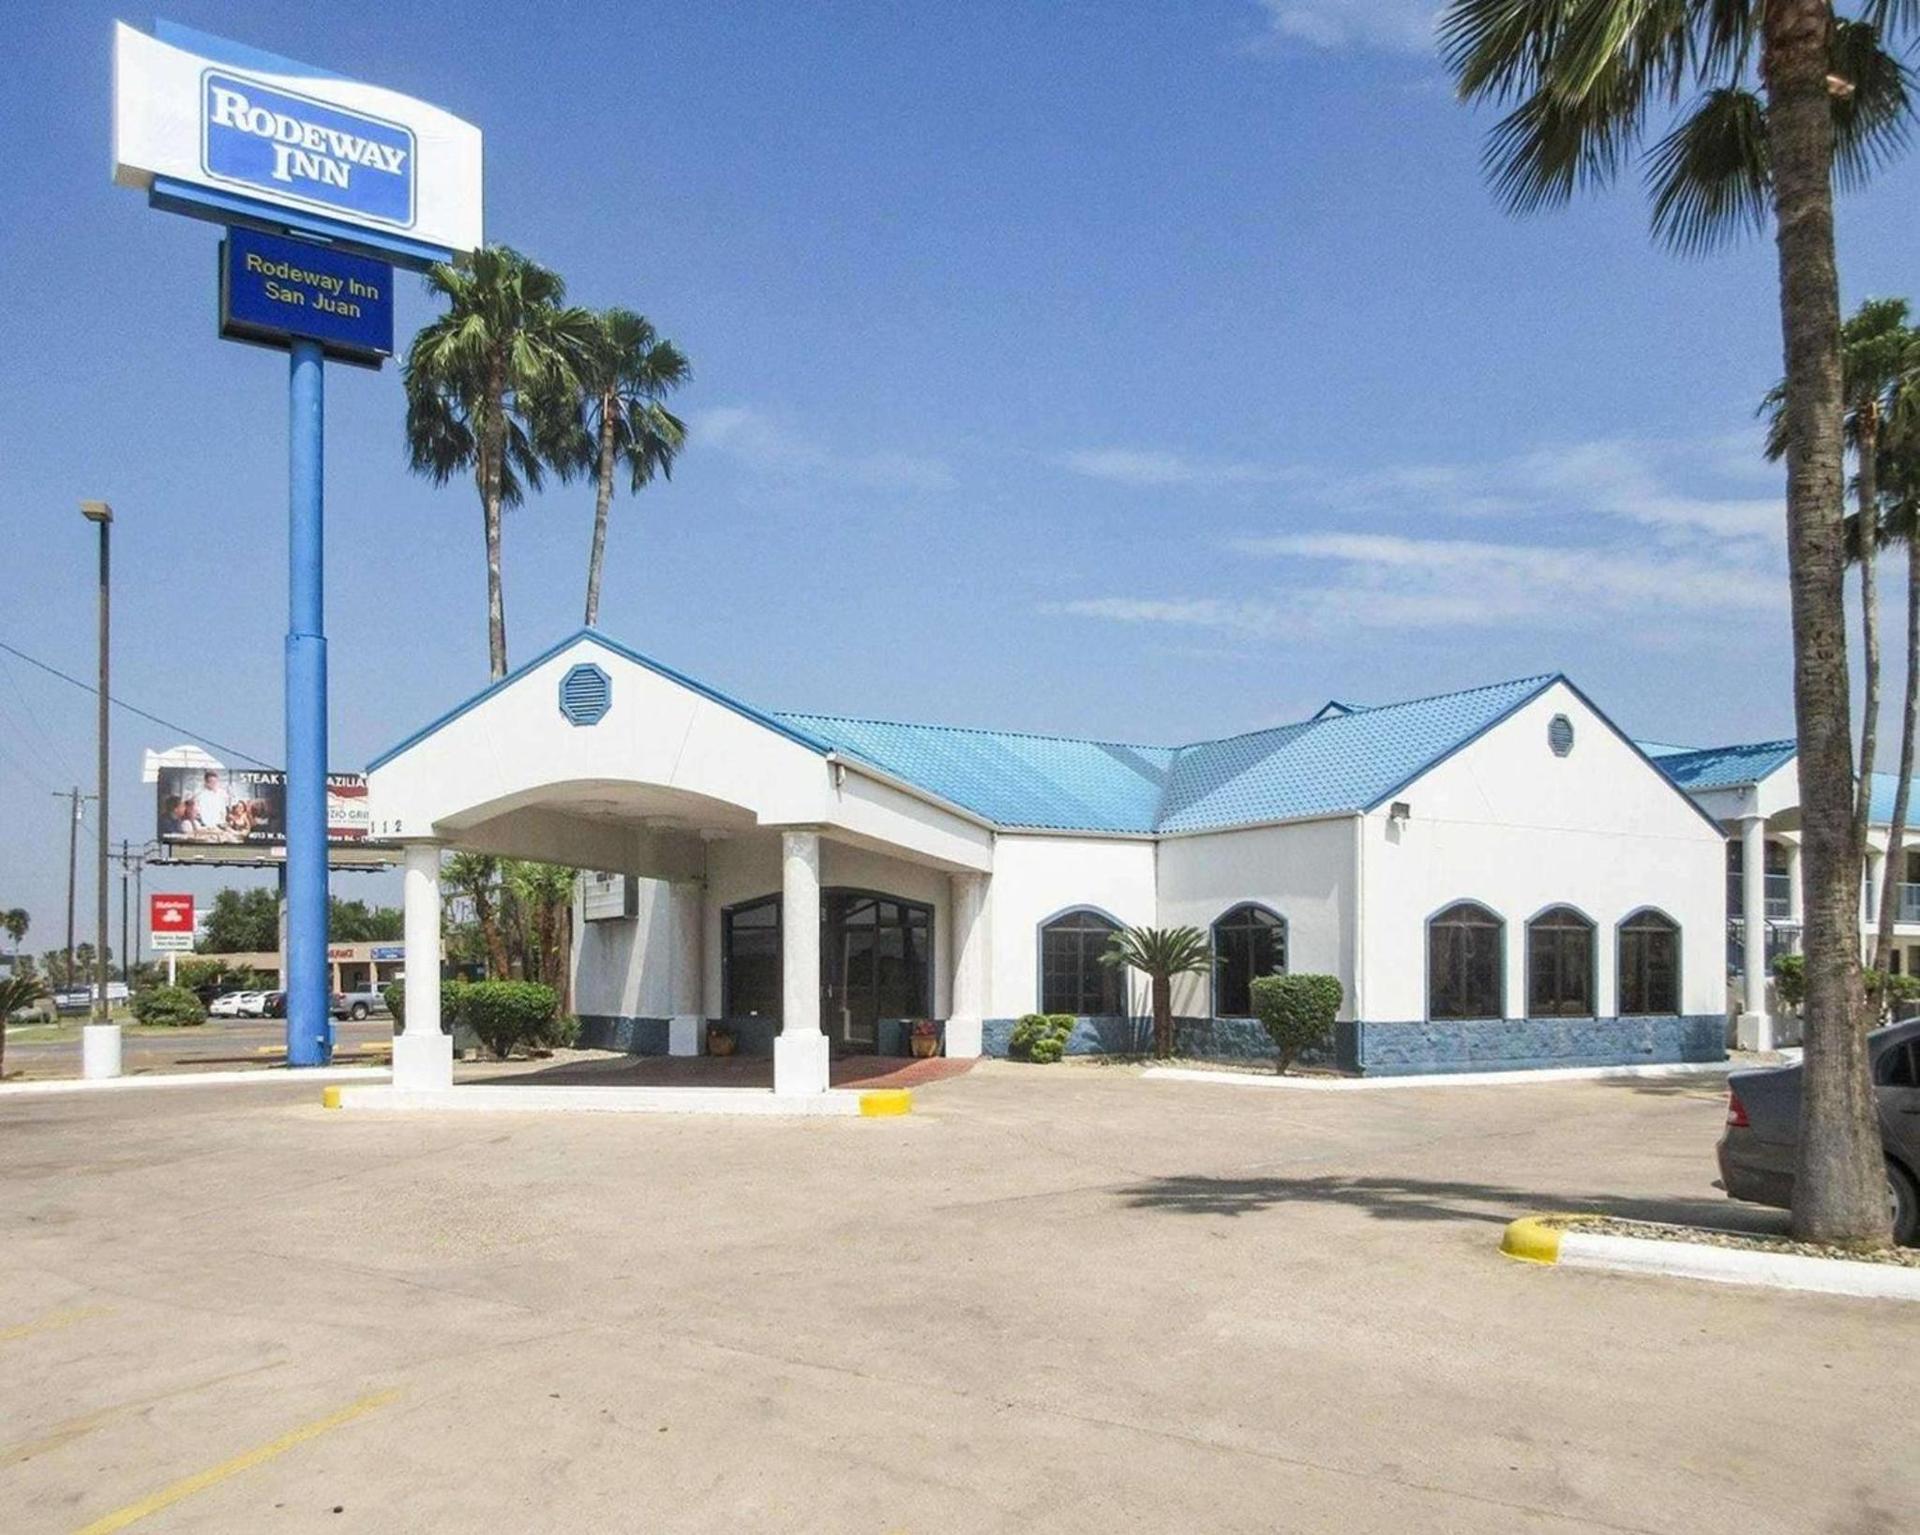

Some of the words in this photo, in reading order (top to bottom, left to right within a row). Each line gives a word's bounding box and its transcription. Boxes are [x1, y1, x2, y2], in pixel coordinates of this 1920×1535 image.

[211, 86, 406, 176] RODEWAY
[271, 144, 351, 189] INN
[246, 253, 343, 295] Rodeway
[349, 277, 379, 300] Inn
[265, 281, 304, 305] San
[312, 288, 361, 318] Juan
[240, 773, 280, 785] STEAK
[327, 776, 369, 788] AZILIA
